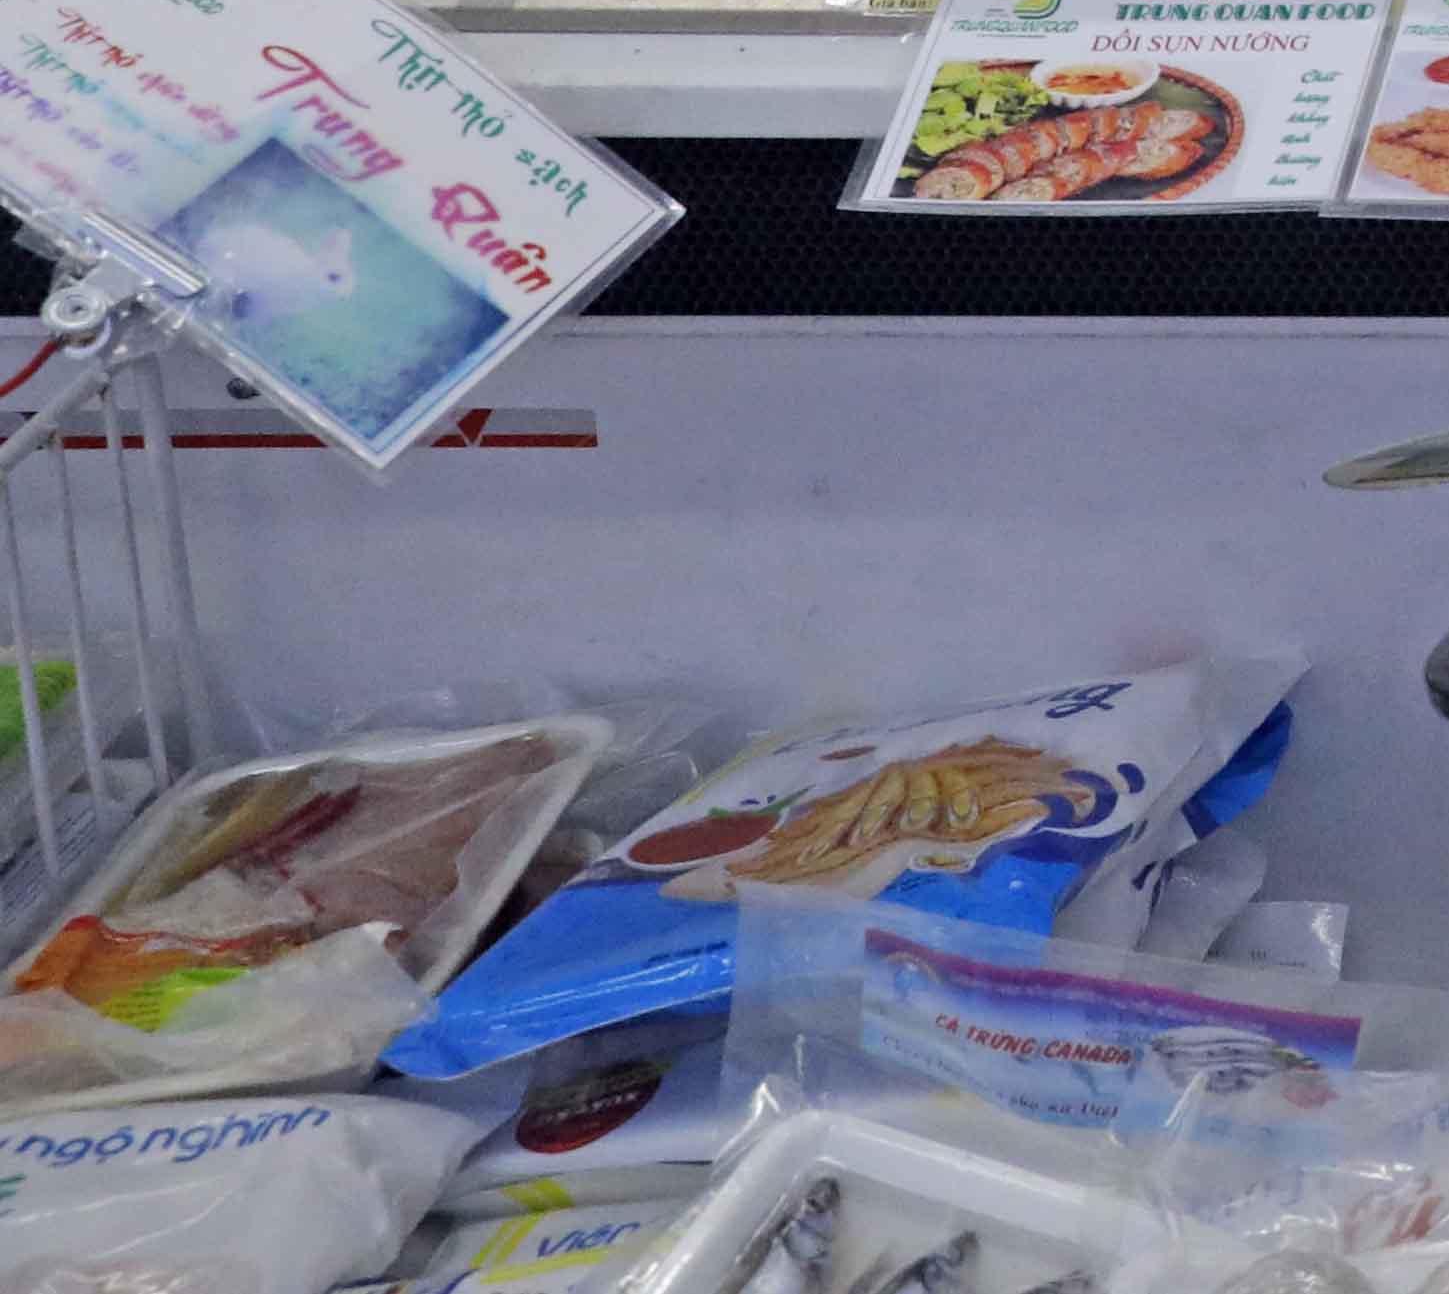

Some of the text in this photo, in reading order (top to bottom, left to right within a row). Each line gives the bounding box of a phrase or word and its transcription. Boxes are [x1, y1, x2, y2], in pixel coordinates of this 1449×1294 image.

[1114, 2, 1207, 22] TRUNG
[1296, 2, 1376, 22] FOOD
[1212, 30, 1310, 53] NƯỚNG
[256, 44, 407, 182] Trung
[1041, 1038, 1136, 1067] CANADA
